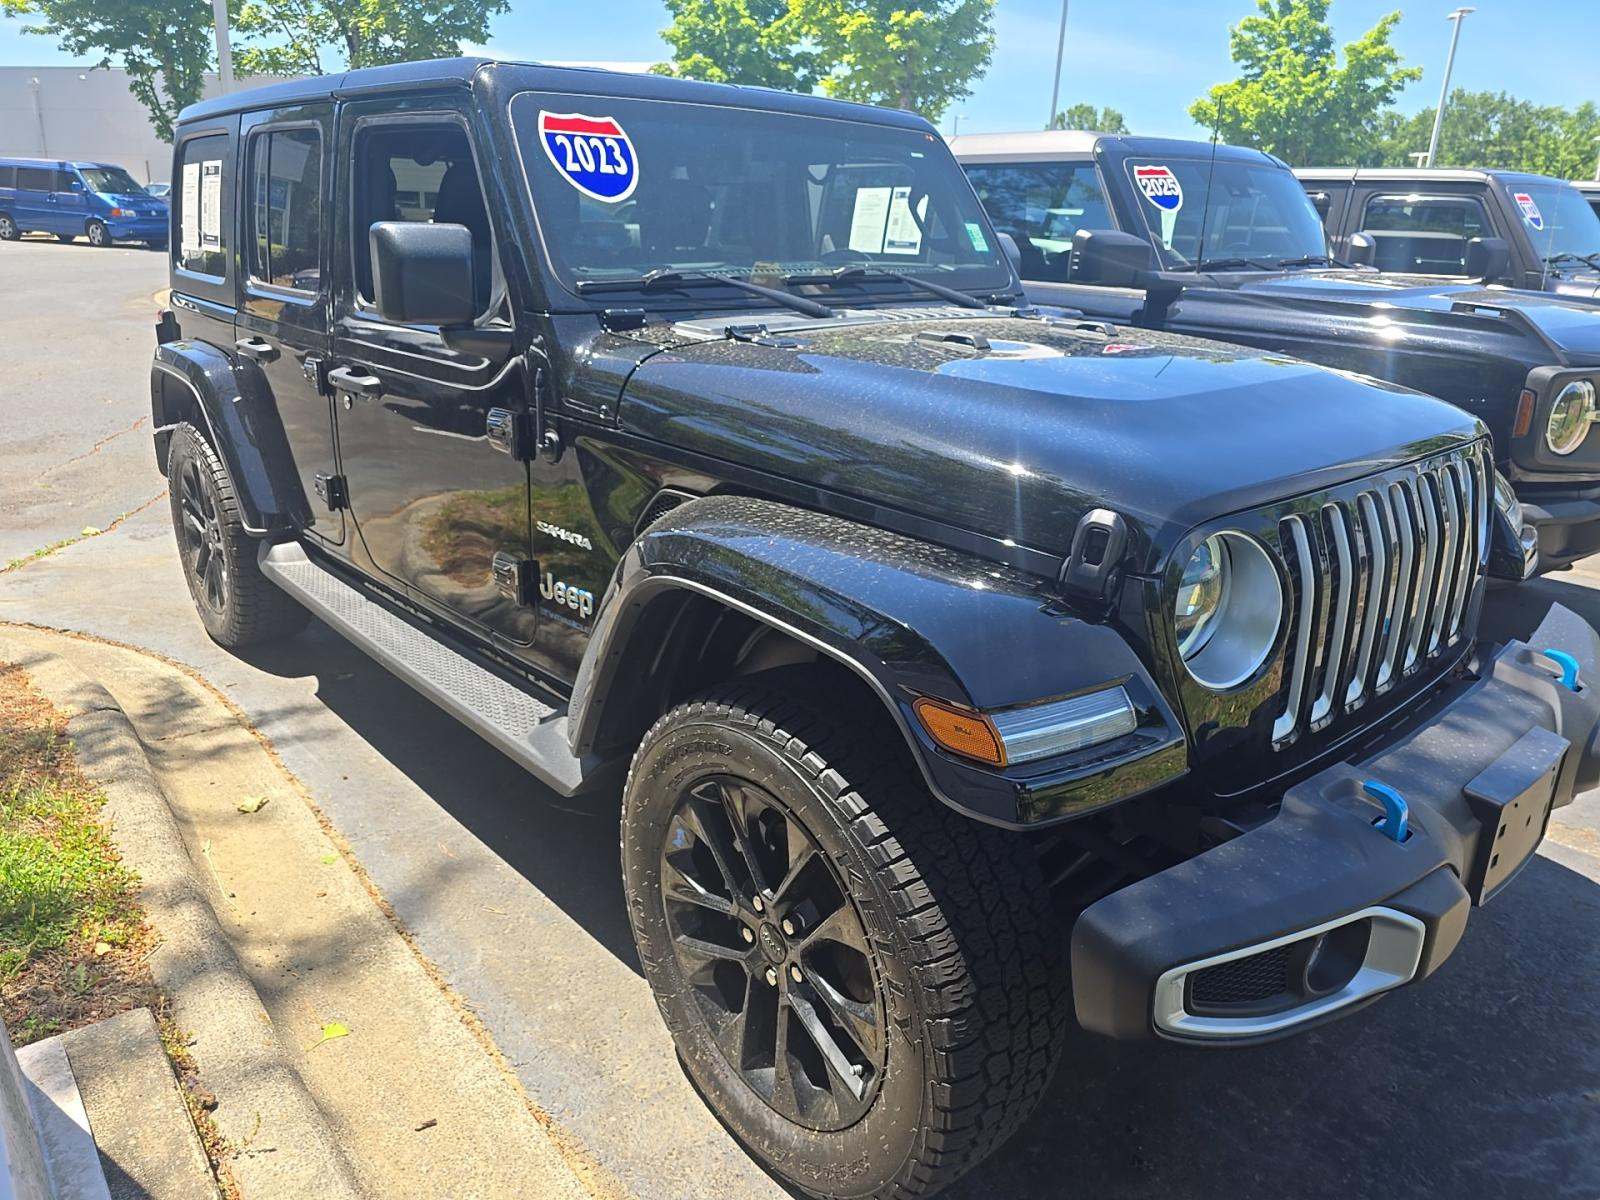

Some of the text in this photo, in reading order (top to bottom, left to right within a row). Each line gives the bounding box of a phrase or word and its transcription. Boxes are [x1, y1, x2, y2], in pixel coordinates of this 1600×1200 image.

[555, 134, 628, 176] 2023
[1140, 177, 1180, 197] 2025
[536, 520, 592, 551] SAHARA
[539, 572, 594, 619] Jeep
